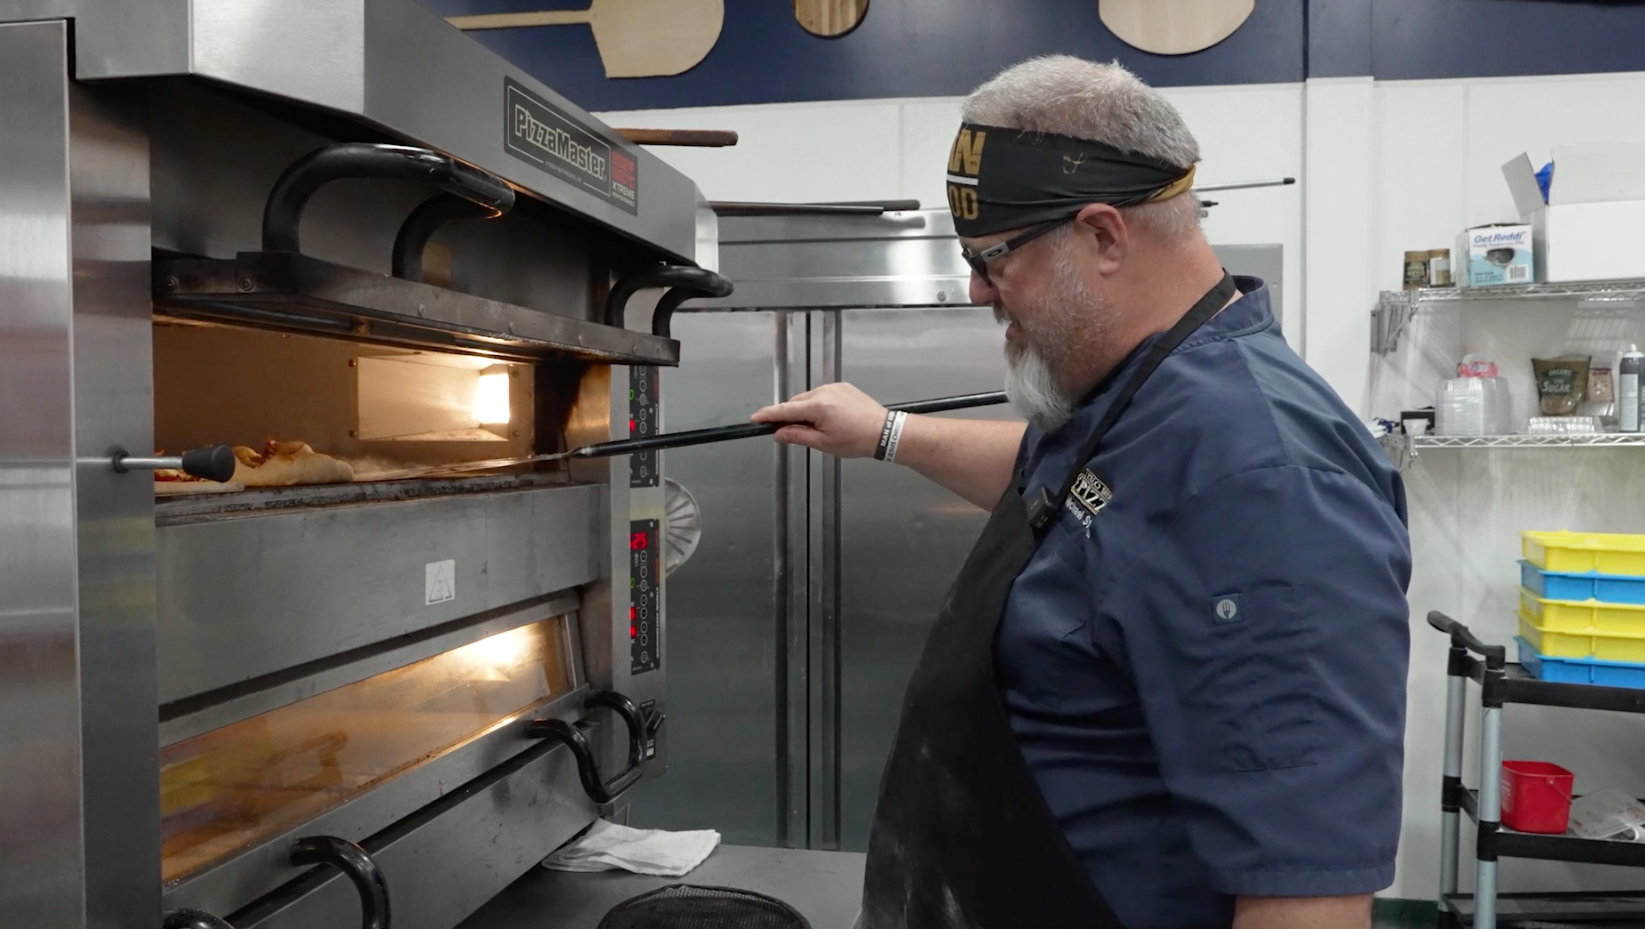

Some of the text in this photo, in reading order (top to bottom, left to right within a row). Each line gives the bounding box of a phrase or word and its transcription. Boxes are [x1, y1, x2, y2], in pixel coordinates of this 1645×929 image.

[515, 103, 606, 181] PizzaMaster
[1474, 232, 1522, 244] Get Reddi
[880, 428, 890, 447] MAN
